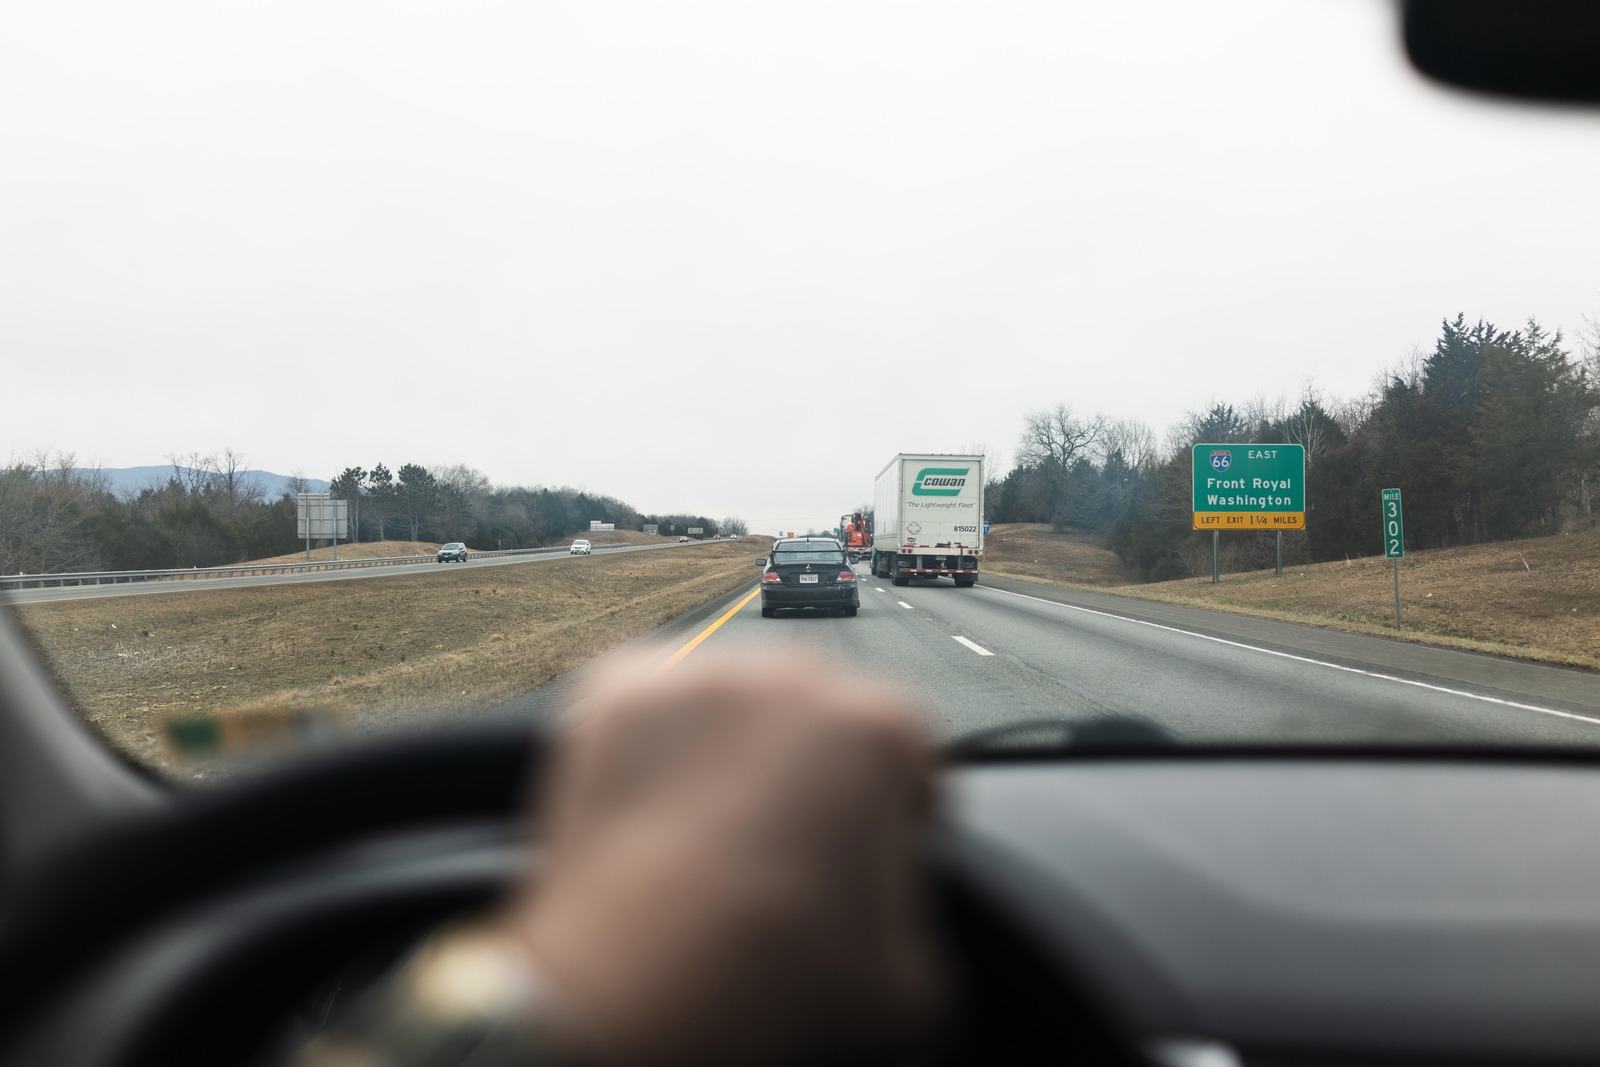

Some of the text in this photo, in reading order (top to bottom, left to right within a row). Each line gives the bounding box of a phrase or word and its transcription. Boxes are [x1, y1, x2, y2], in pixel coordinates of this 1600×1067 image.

[1212, 450, 1277, 468] 66 EAST
[1207, 478, 1291, 491] Front Royal
[1207, 494, 1292, 508] Washington
